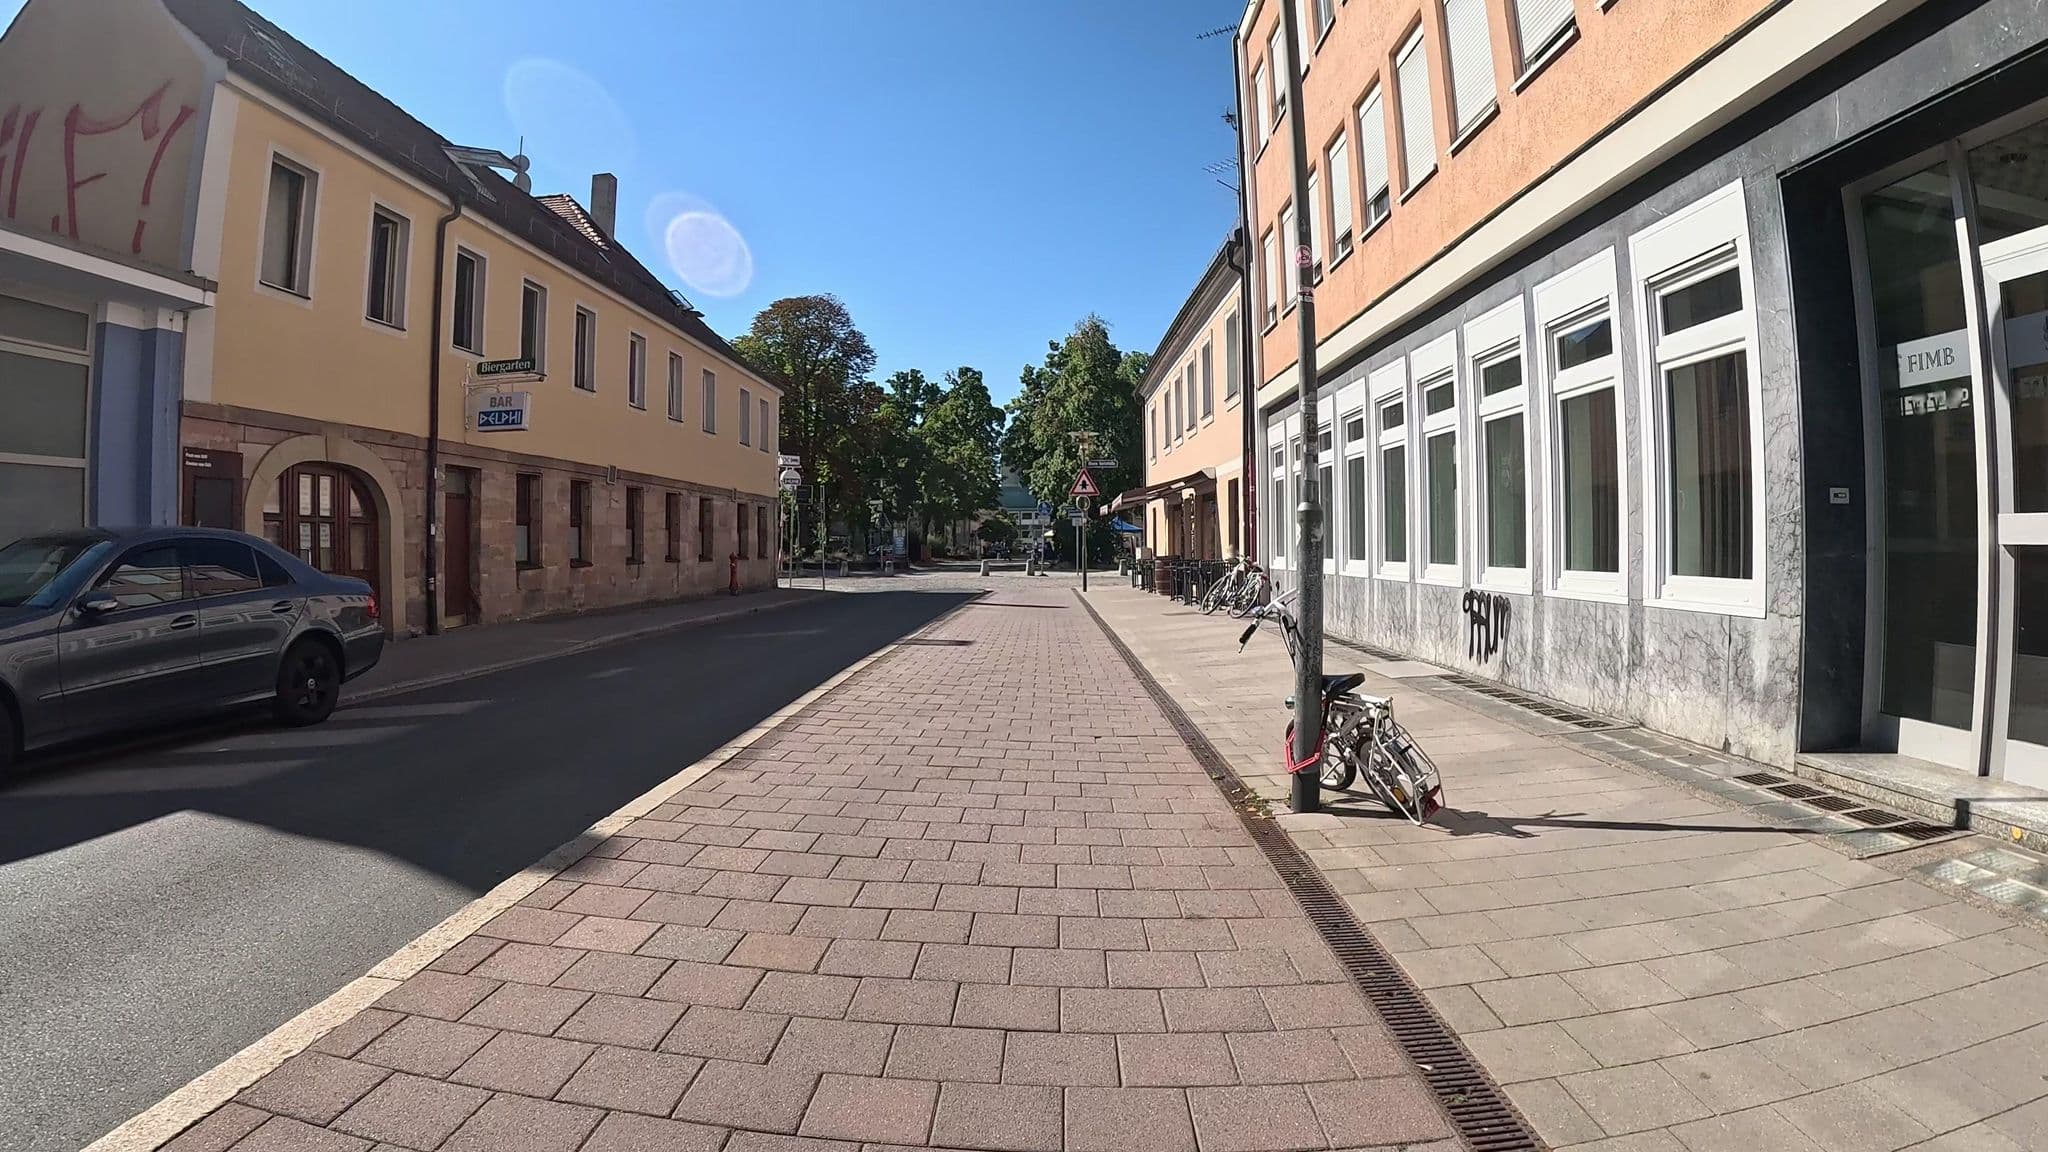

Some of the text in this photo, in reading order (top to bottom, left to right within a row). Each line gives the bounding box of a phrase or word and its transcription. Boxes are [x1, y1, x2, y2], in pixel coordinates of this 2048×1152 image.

[481, 360, 531, 374] Biergarten
[1907, 347, 1955, 373] FIMB
[490, 396, 513, 408] BAR
[479, 410, 521, 425] DELPHI
